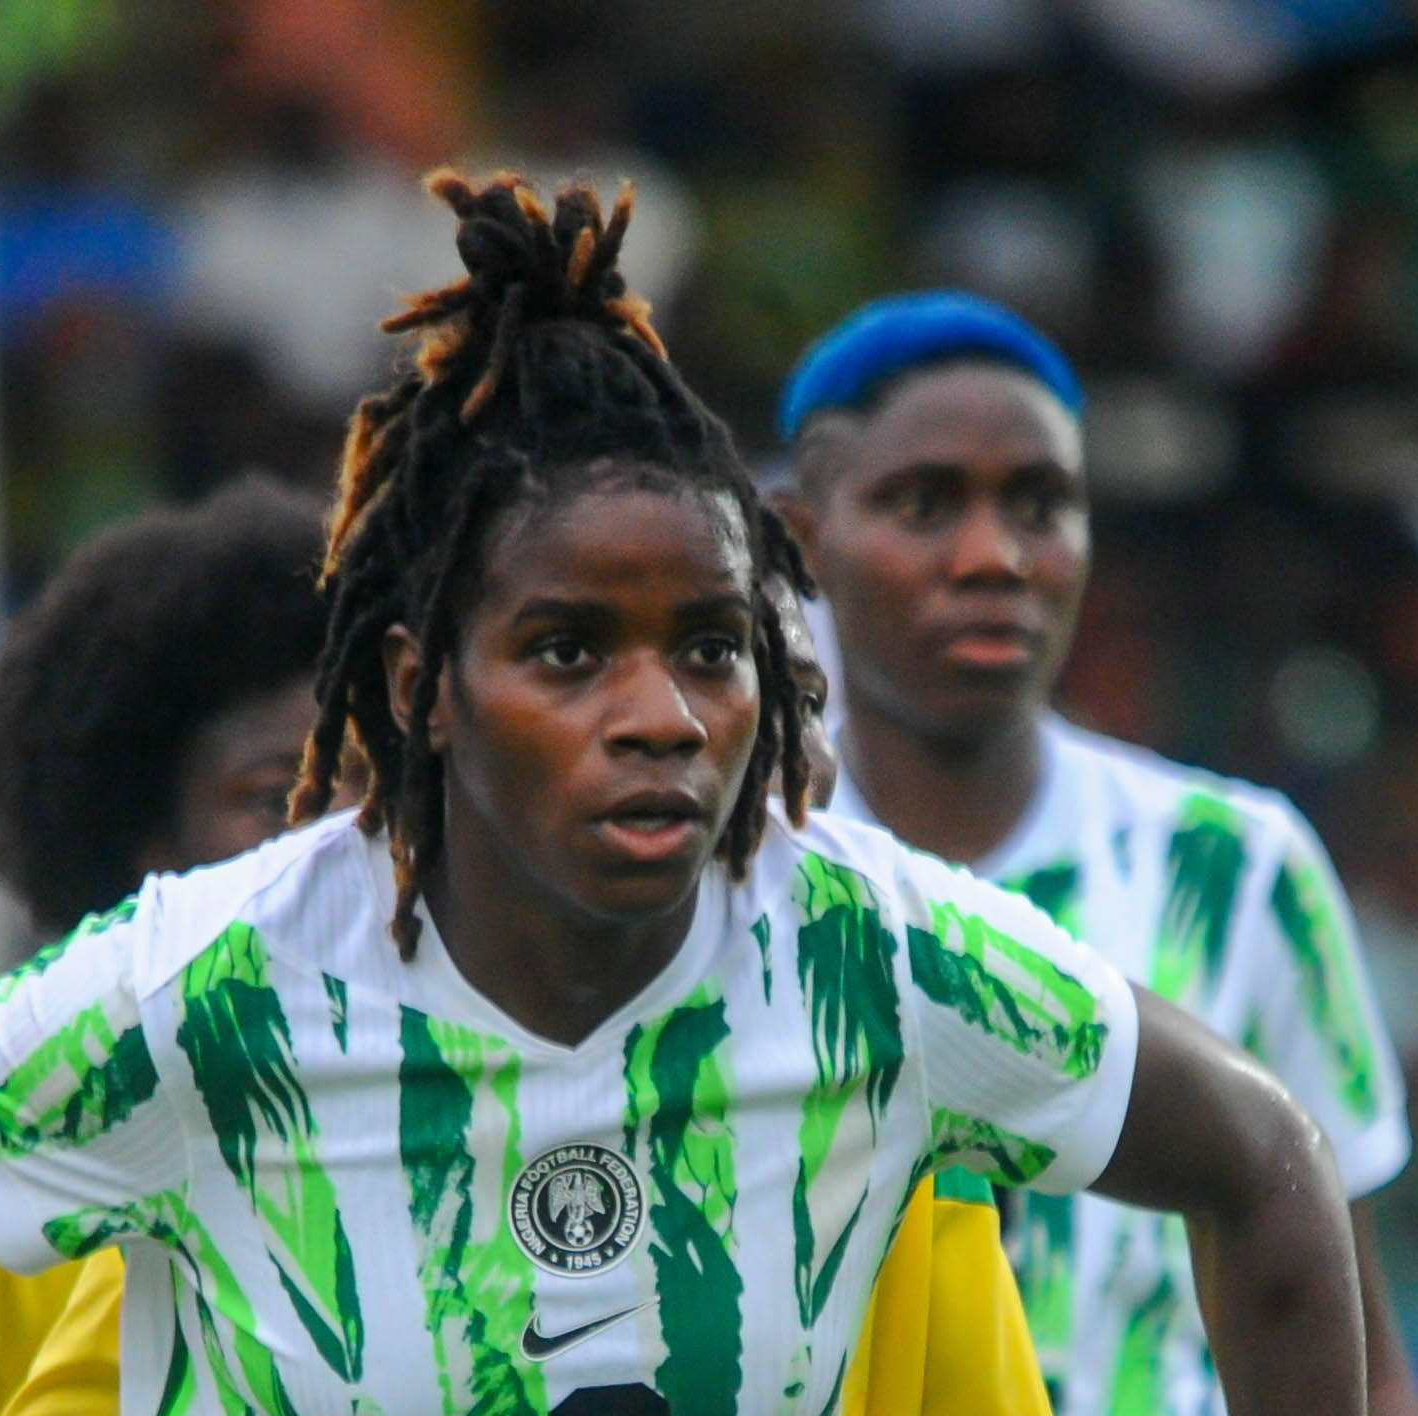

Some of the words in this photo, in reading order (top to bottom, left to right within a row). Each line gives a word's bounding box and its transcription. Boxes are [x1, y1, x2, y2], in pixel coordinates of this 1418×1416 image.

[520, 1148, 597, 1191] FOOTBALL
[514, 1192, 546, 1256] NIGERIA
[599, 1153, 639, 1247] FEDERATION
[566, 1252, 602, 1270] 1945
